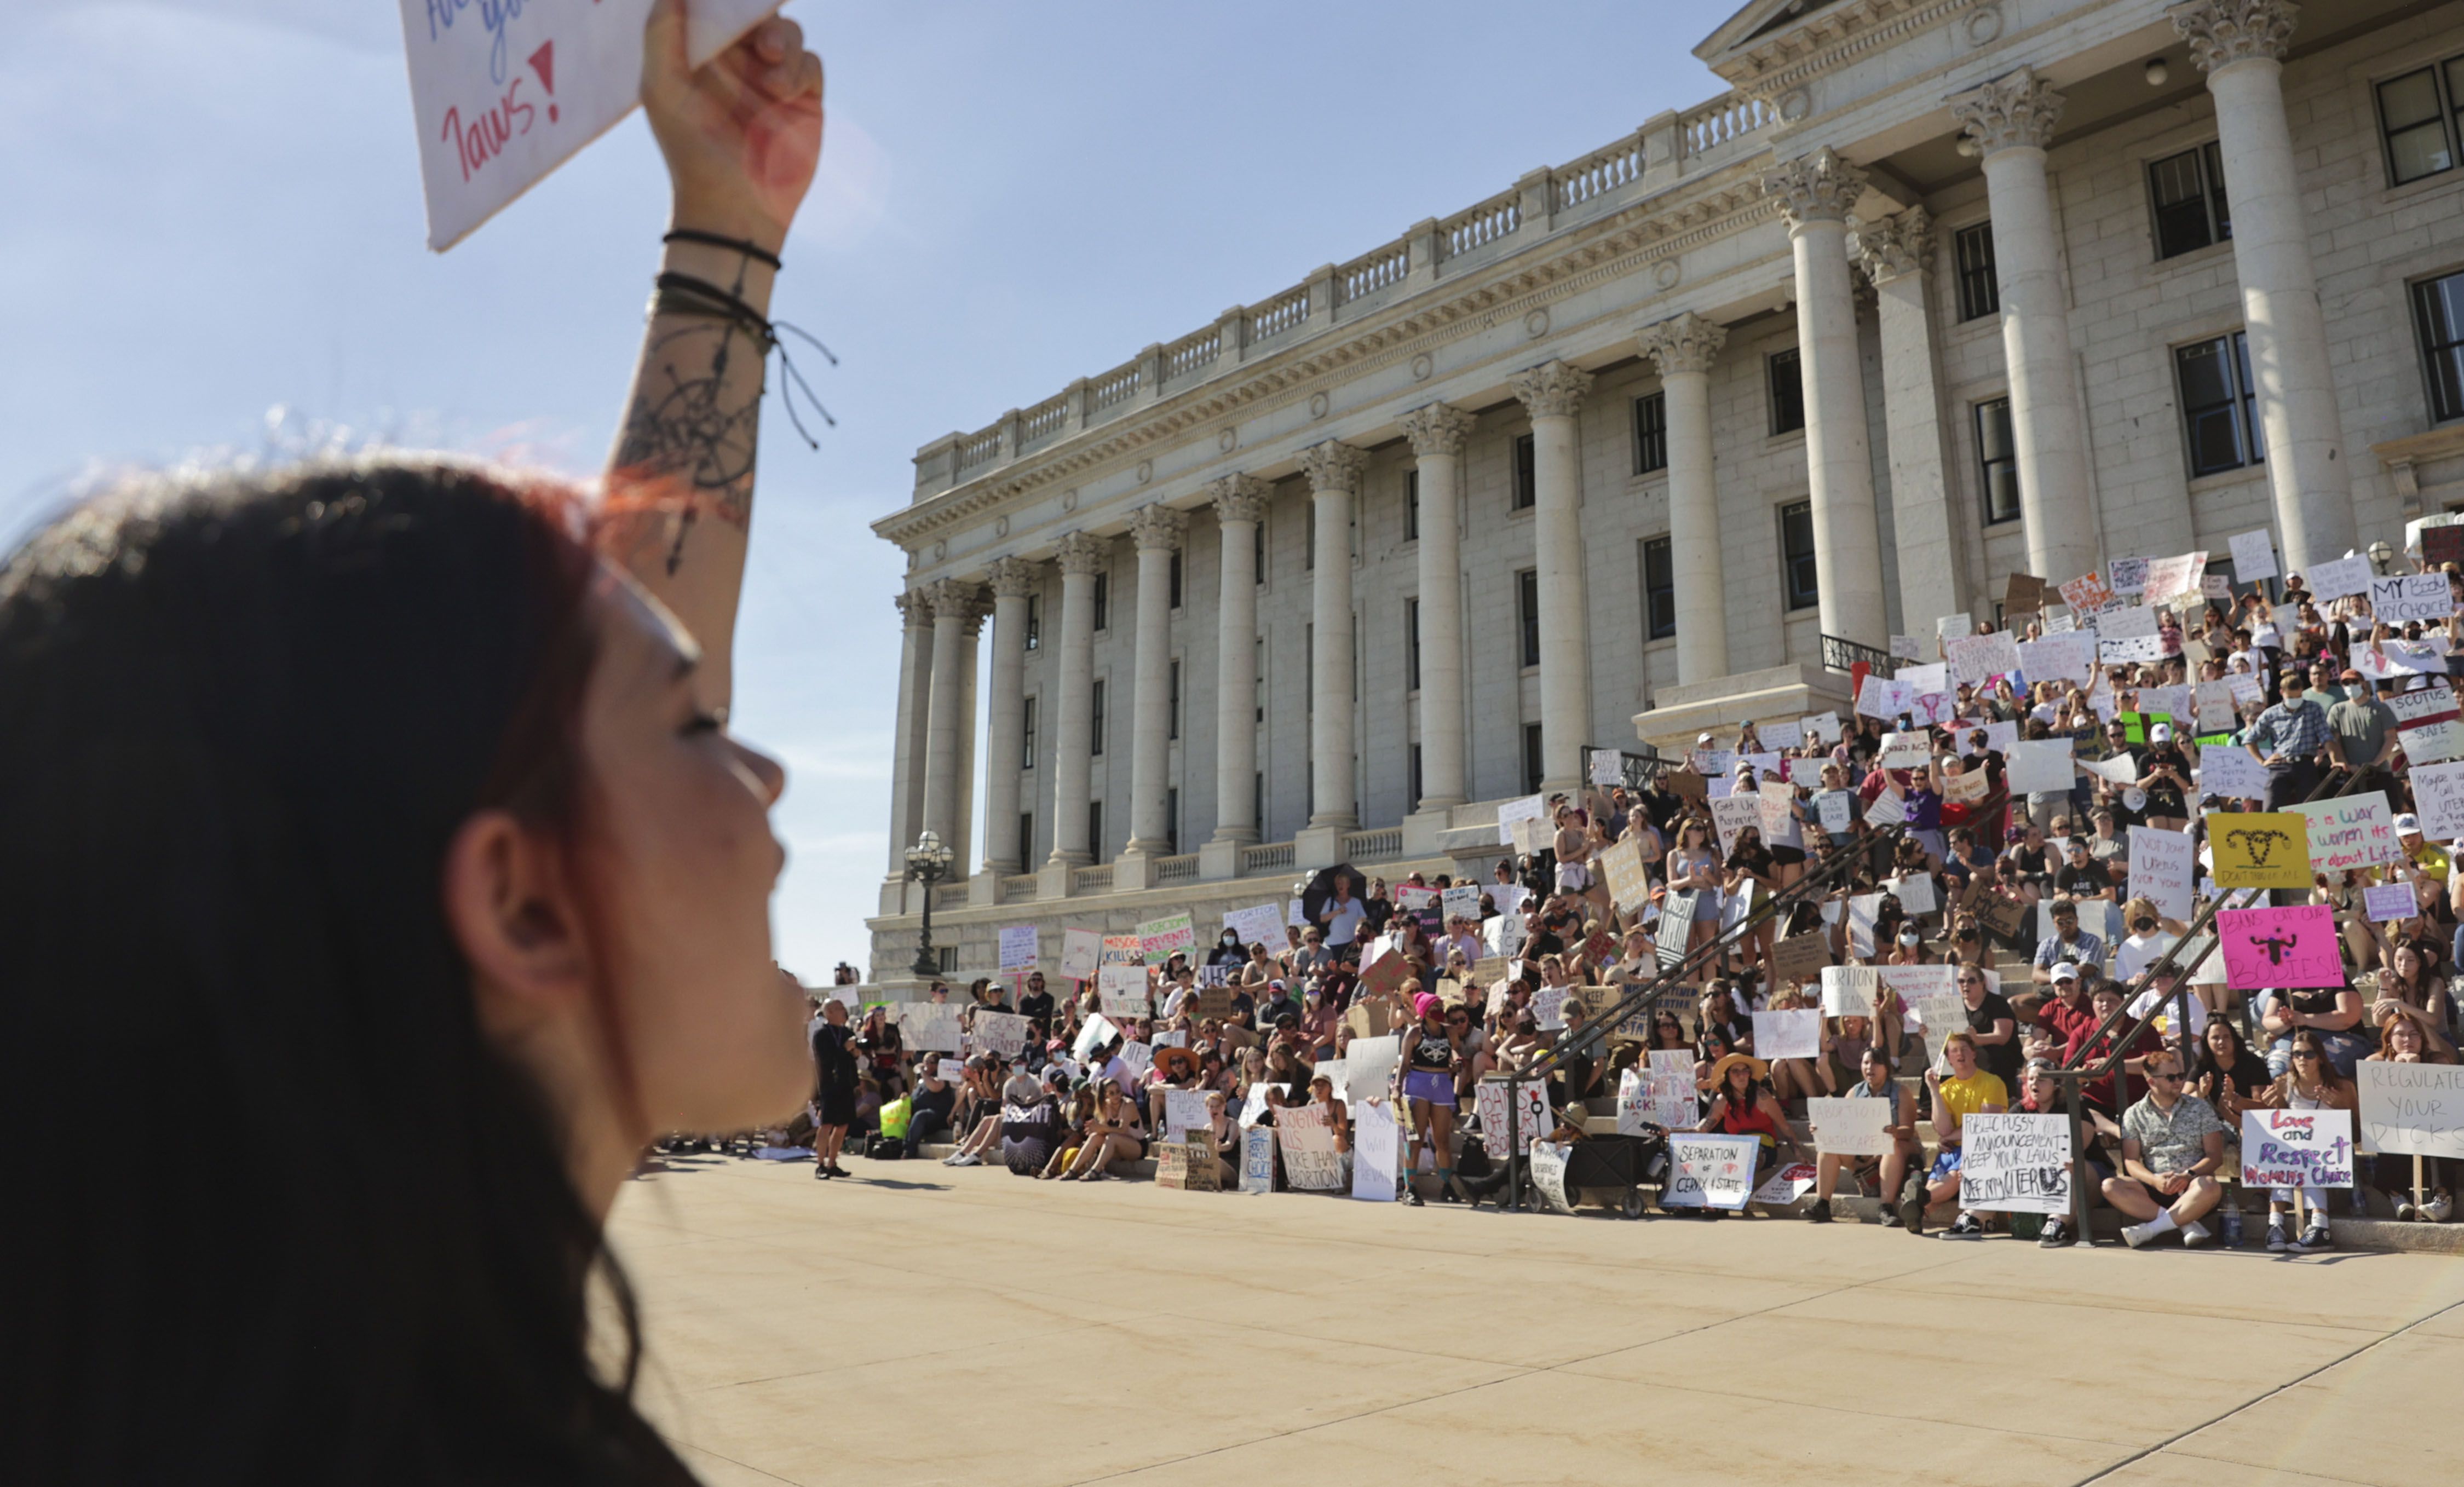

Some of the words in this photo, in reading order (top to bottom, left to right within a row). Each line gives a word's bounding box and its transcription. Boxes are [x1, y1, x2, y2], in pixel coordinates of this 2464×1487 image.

[2374, 578, 2403, 602] MY
[2396, 688, 2446, 710] SCOTUS
[2415, 722, 2449, 740] SAFE
[1651, 1052, 1694, 1075] BANS
[1622, 1099, 1657, 1111] BACK!
[2387, 1096, 2448, 1119] YOUR
[1839, 1121, 1848, 1130] IS
[2002, 1116, 2036, 1133] PUSSY
[2282, 1128, 2314, 1141] and
[1282, 1150, 1310, 1169] MORE
[1311, 1150, 1339, 1168] THAN
[1679, 1146, 1738, 1163] SEPARATION
[1963, 1152, 1992, 1171] KEEP
[1994, 1150, 2025, 1167] YOUR
[2026, 1151, 2059, 1164] LAWS
[2259, 1136, 2350, 1168] Respect
[1288, 1168, 1341, 1188] ABORTION
[1964, 1177, 1983, 1199] OFF
[2005, 1167, 2068, 1196] UTERUS
[2311, 1165, 2351, 1185] Choice
[1716, 1178, 1743, 1194] STATE
